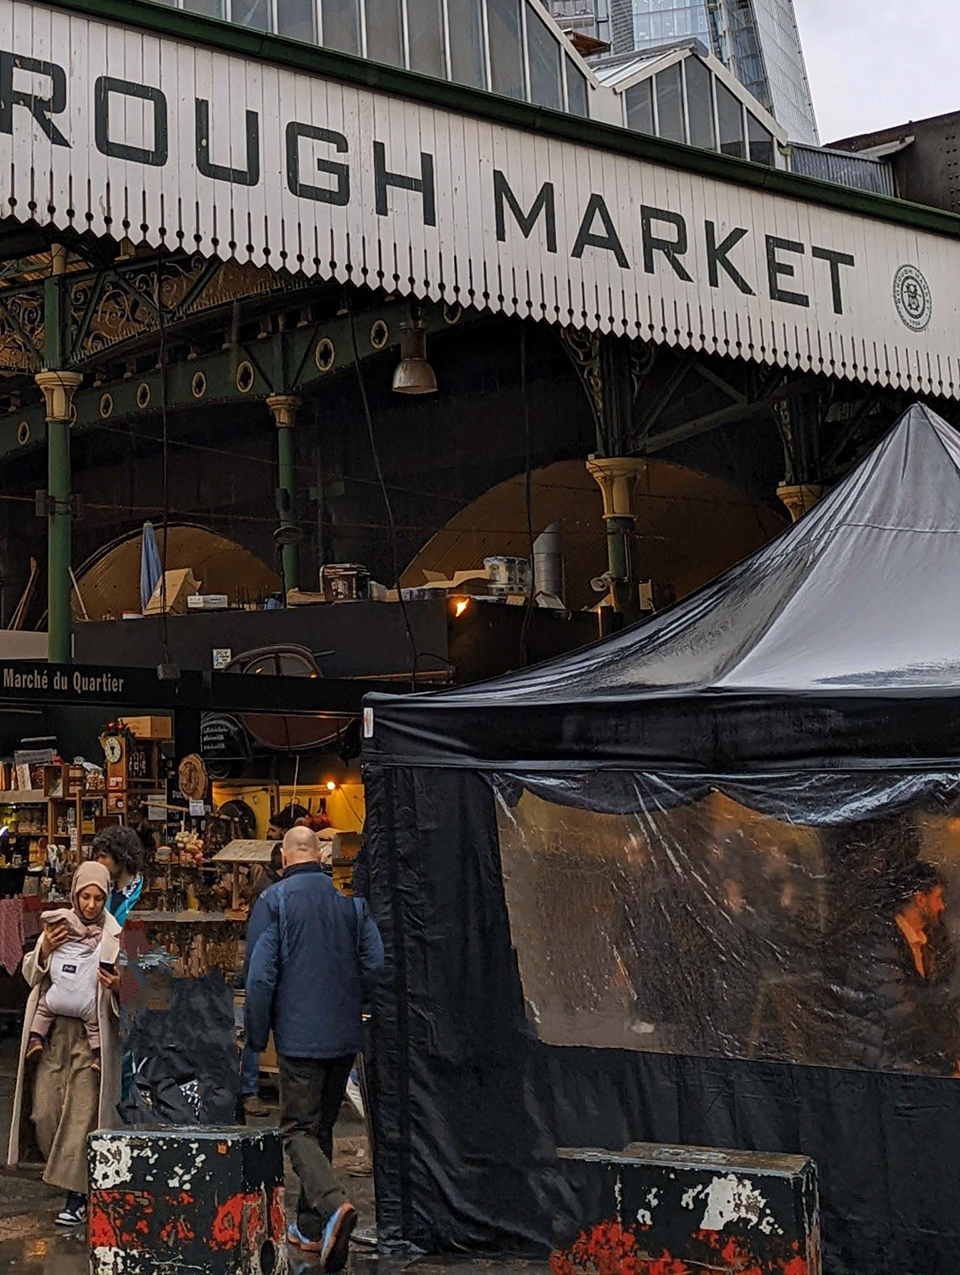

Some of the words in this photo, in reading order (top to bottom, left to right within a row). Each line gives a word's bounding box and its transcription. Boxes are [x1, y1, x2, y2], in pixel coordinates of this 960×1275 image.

[493, 168, 855, 315] MARKET
[3, 668, 48, 689] Marché
[53, 671, 68, 690] du
[73, 671, 124, 694] Quartier
